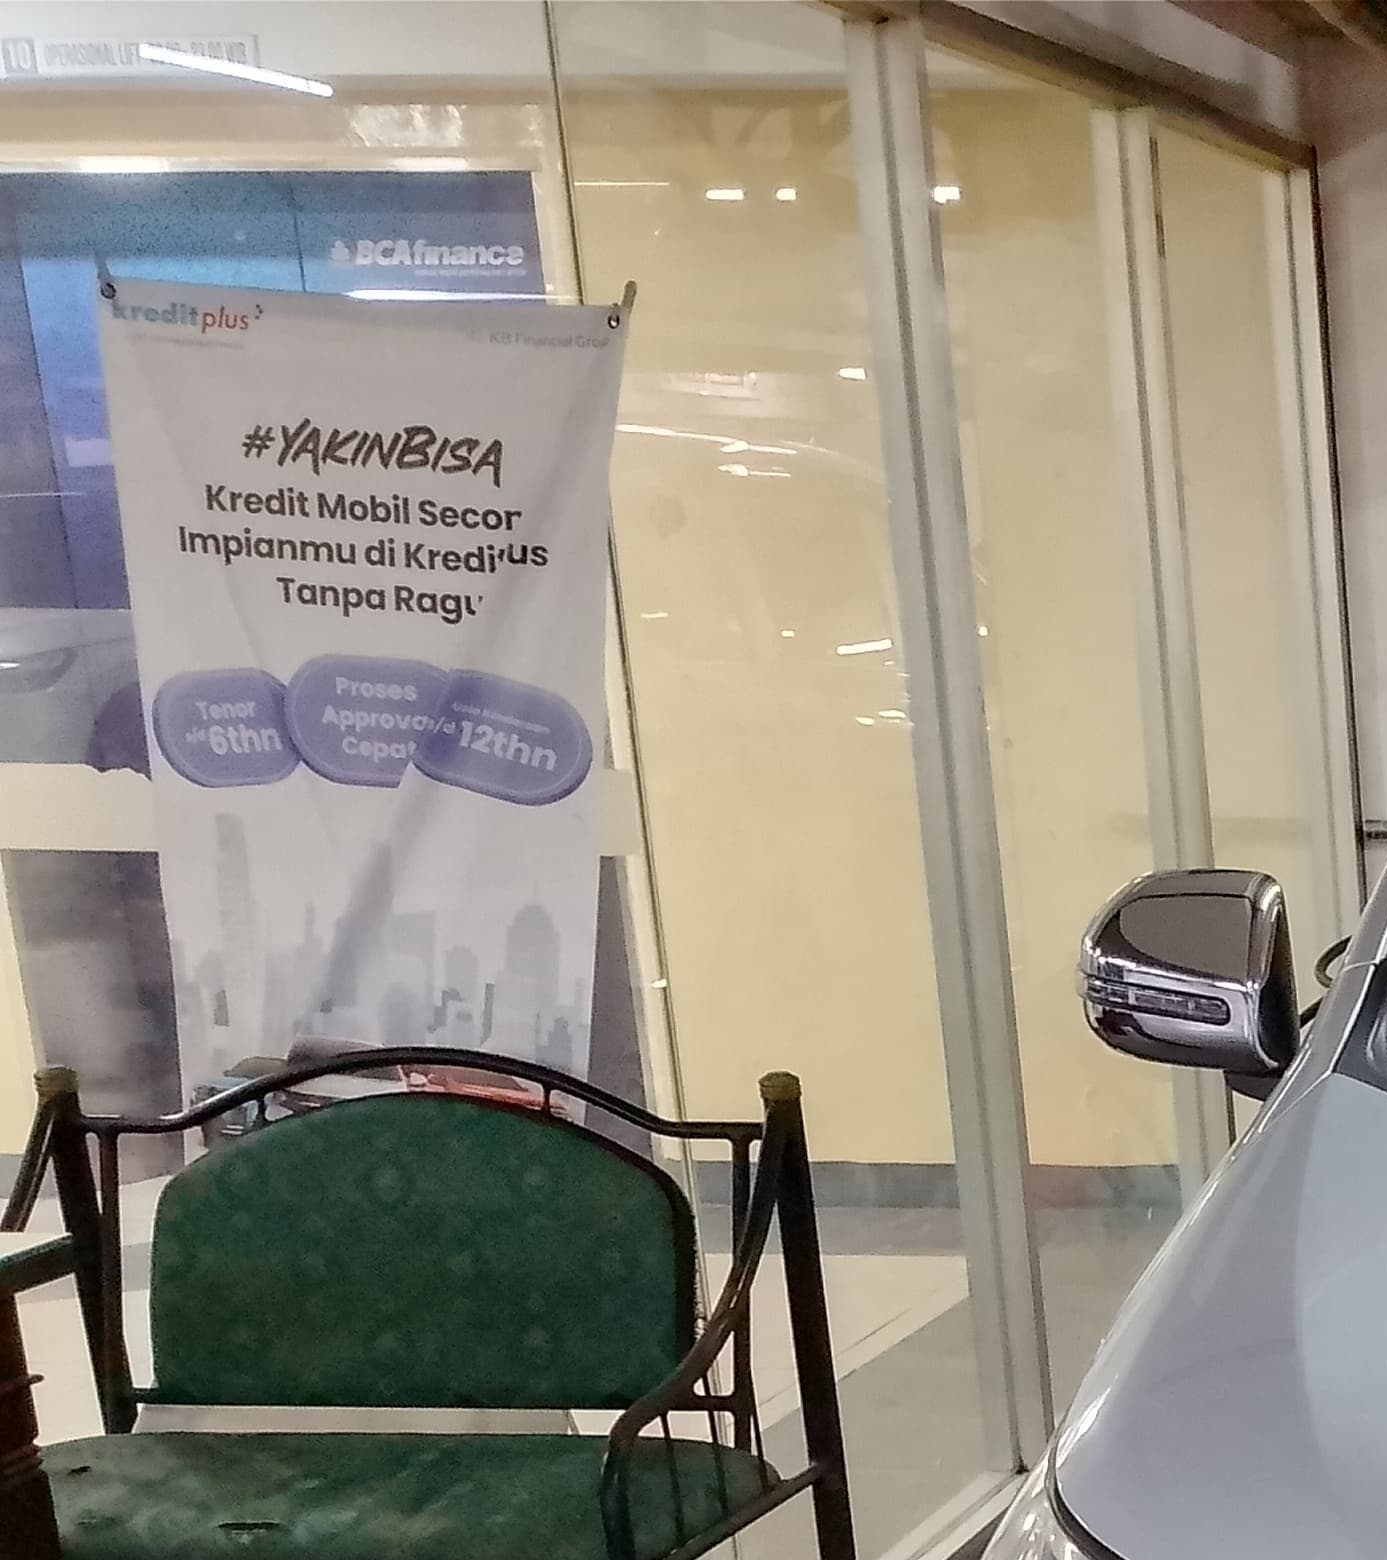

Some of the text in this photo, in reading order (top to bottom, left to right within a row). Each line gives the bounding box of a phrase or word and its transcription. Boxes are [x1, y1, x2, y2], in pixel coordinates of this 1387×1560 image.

[205, 484, 310, 518] Kredit
[317, 492, 411, 526] Mobil
[178, 526, 357, 565] Impianmu
[364, 538, 396, 568] di
[276, 576, 386, 617] Tanpa
[335, 676, 417, 702] Proses
[195, 701, 256, 721] Tenor
[208, 724, 283, 756] 6thn
[459, 720, 557, 770] 12thn
